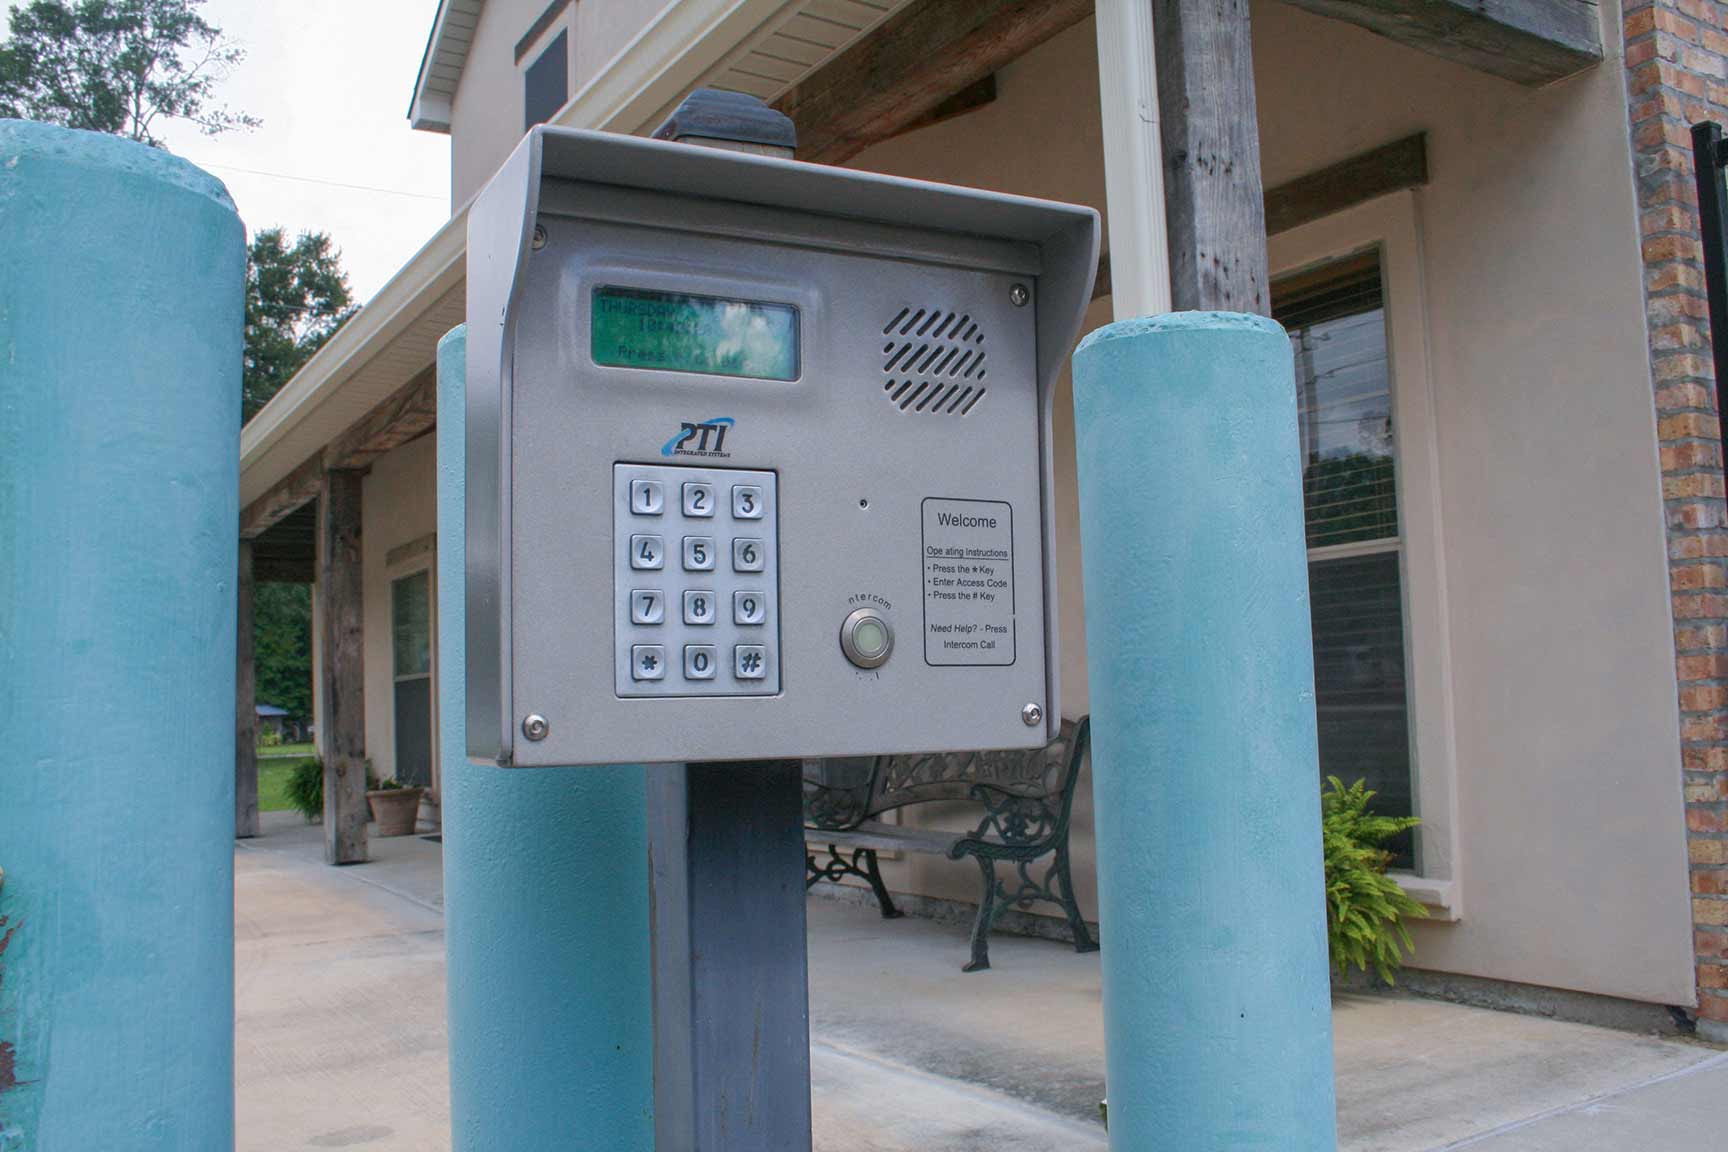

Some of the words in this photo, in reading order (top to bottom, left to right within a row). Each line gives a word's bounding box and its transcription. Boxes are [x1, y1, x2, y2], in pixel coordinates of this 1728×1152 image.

[675, 422, 728, 451] PTI
[674, 449, 708, 457] INTEGRATED
[643, 487, 652, 507] 1
[693, 490, 705, 510] 2
[742, 493, 755, 514] 3
[938, 512, 997, 528] Welcome
[640, 541, 655, 562] 4
[693, 544, 706, 564] 5
[742, 544, 756, 564] 6
[926, 545, 964, 558] Opeating
[965, 547, 1008, 558] Instructions
[933, 564, 956, 574] Press
[957, 564, 970, 574] the
[979, 565, 995, 576] Key
[933, 577, 955, 587] Enter
[956, 578, 985, 588] Access
[986, 578, 1008, 588] Code
[848, 592, 893, 610] ntercom
[933, 590, 956, 600] Press
[958, 591, 971, 600] the
[972, 591, 978, 600] #
[980, 591, 996, 602] Key
[642, 596, 655, 617] 7
[693, 597, 706, 617] 8
[742, 598, 756, 618] 9
[930, 623, 952, 633] Need
[954, 623, 978, 634] Help?
[985, 624, 1008, 634] Press
[943, 639, 978, 649] Intercom
[980, 640, 996, 649] Call
[694, 652, 708, 671] 0
[742, 652, 761, 673] #
